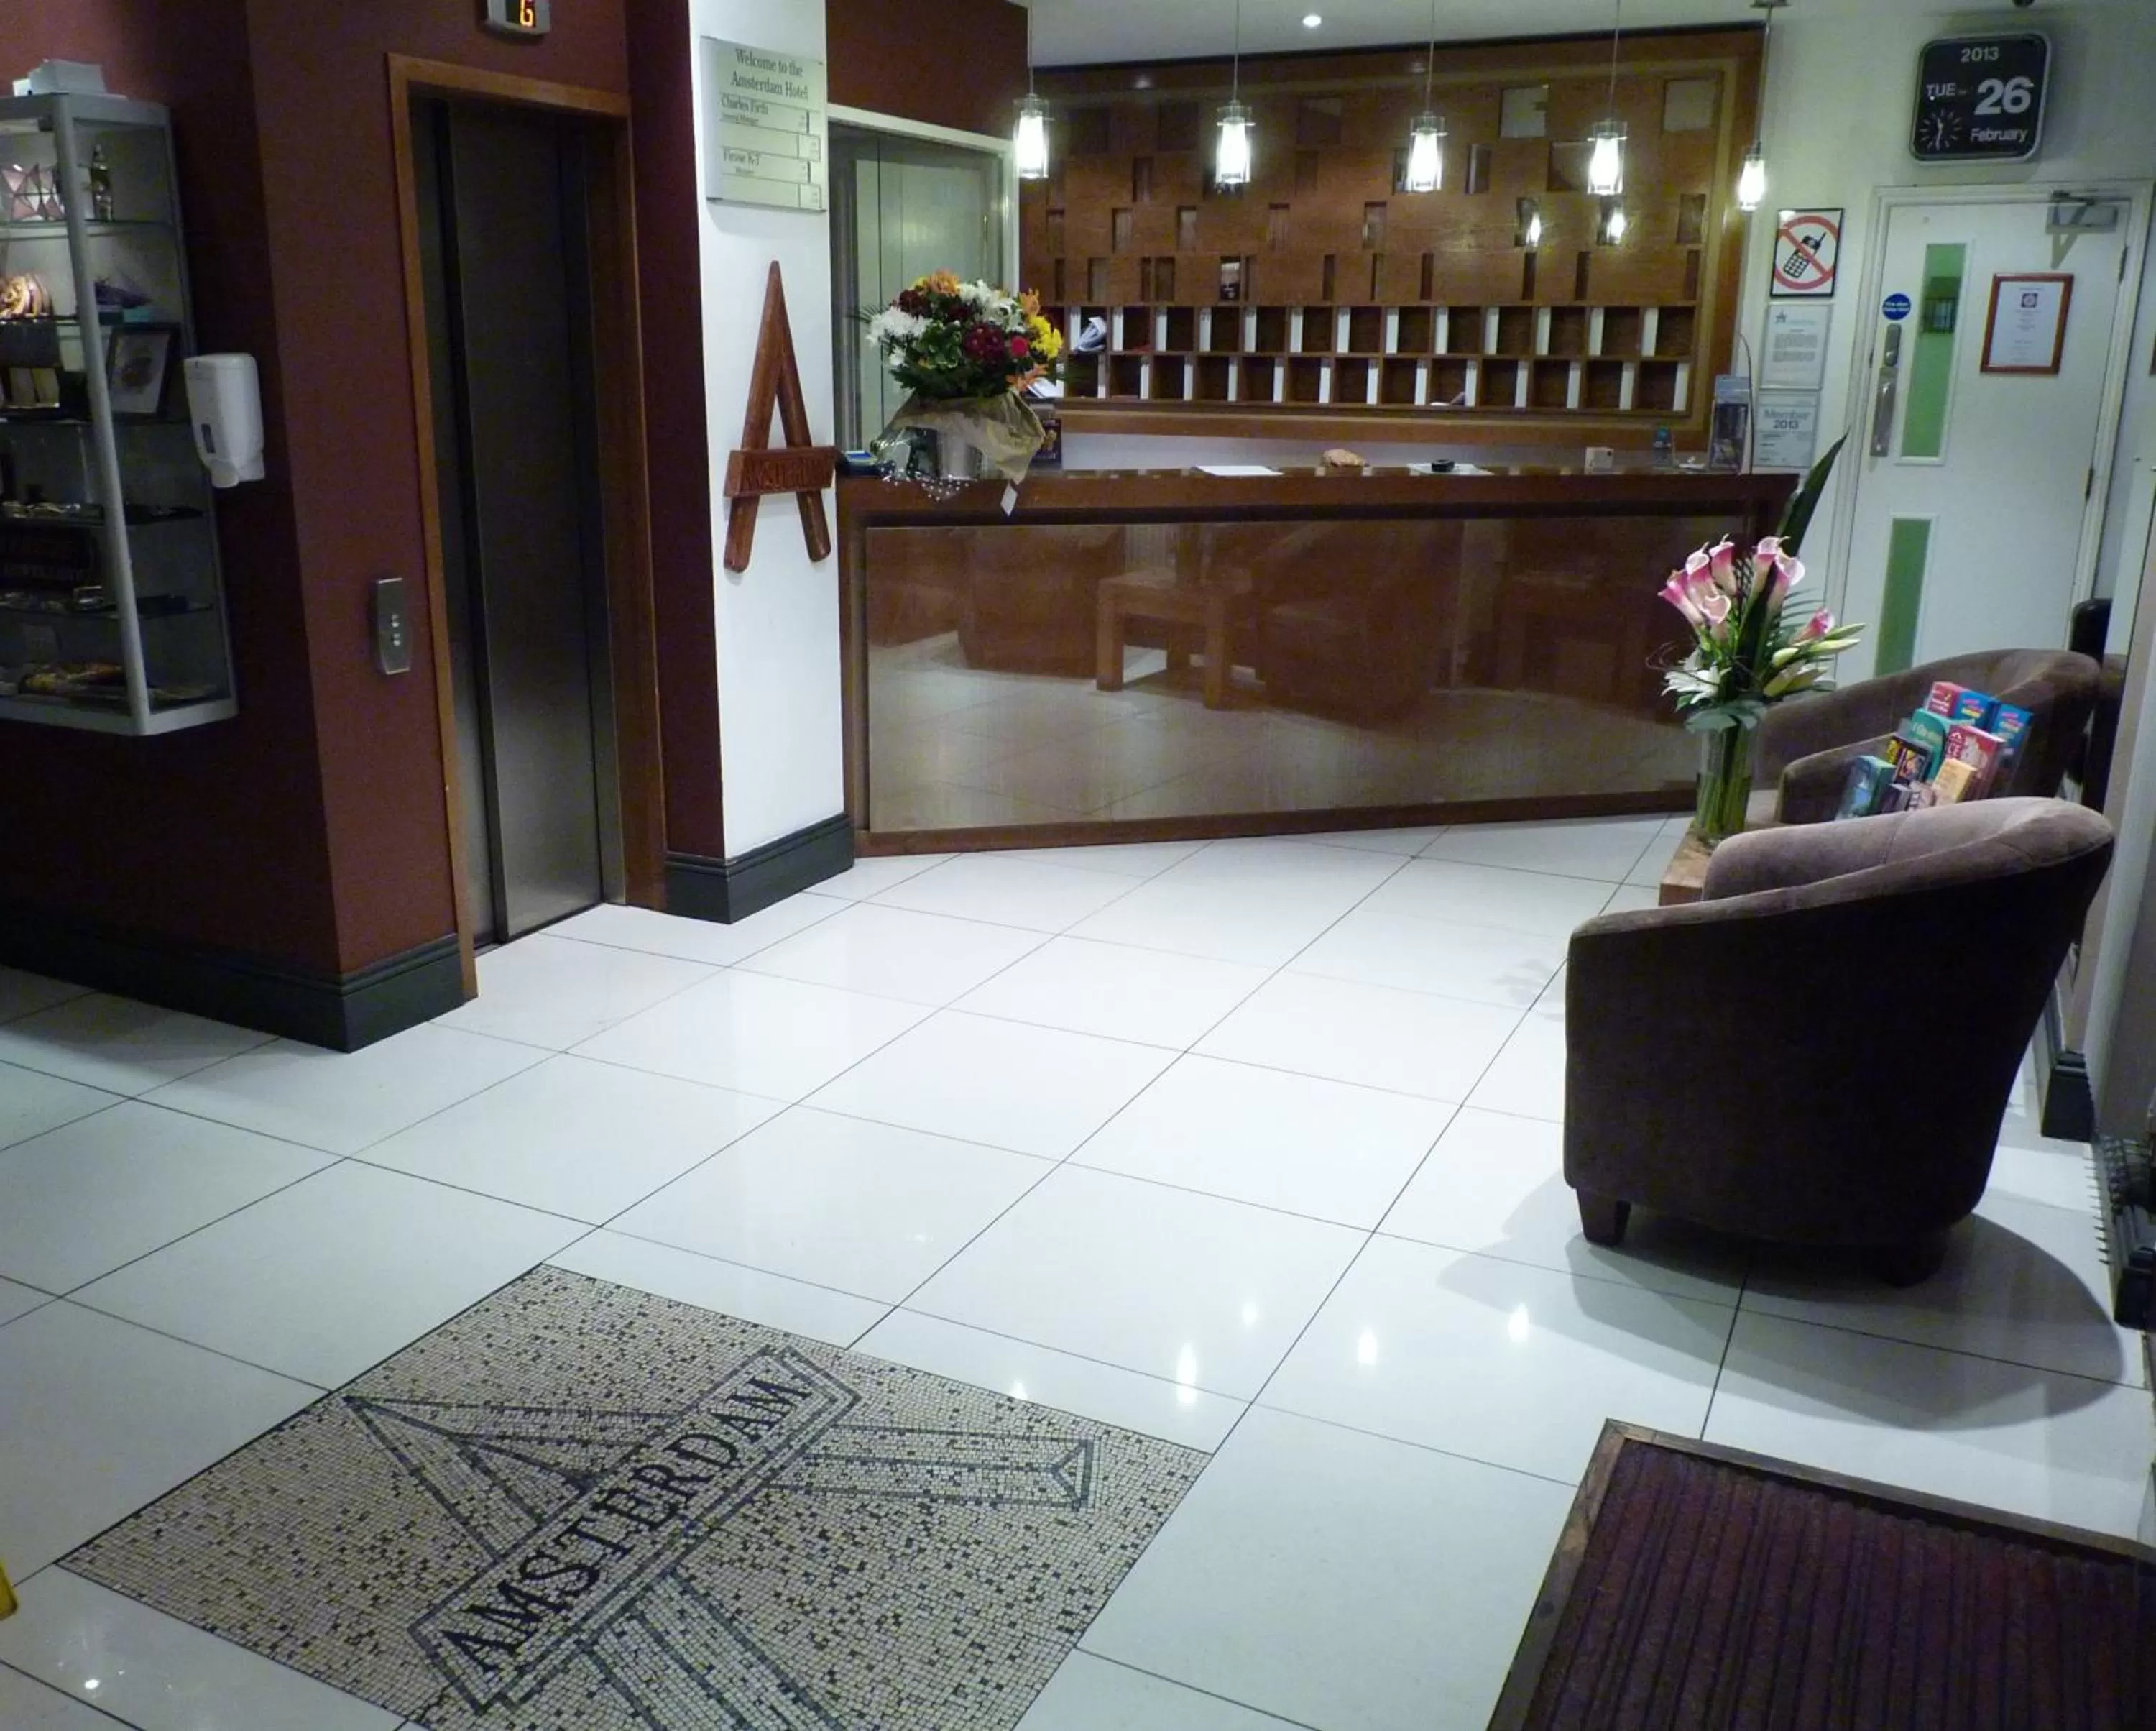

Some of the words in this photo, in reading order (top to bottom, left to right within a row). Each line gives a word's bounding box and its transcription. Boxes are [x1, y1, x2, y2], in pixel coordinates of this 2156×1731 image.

[734, 47, 777, 71] Welcome
[778, 60, 787, 74] to
[788, 60, 803, 77] the
[1960, 46, 1999, 63] 2013
[730, 70, 783, 95] Amsterdam
[785, 80, 808, 101] Hotel
[1926, 83, 1956, 97] TUE
[1973, 75, 2033, 116] 26
[1969, 127, 2029, 143] February
[441, 1375, 812, 1673] AMSTERDAM
